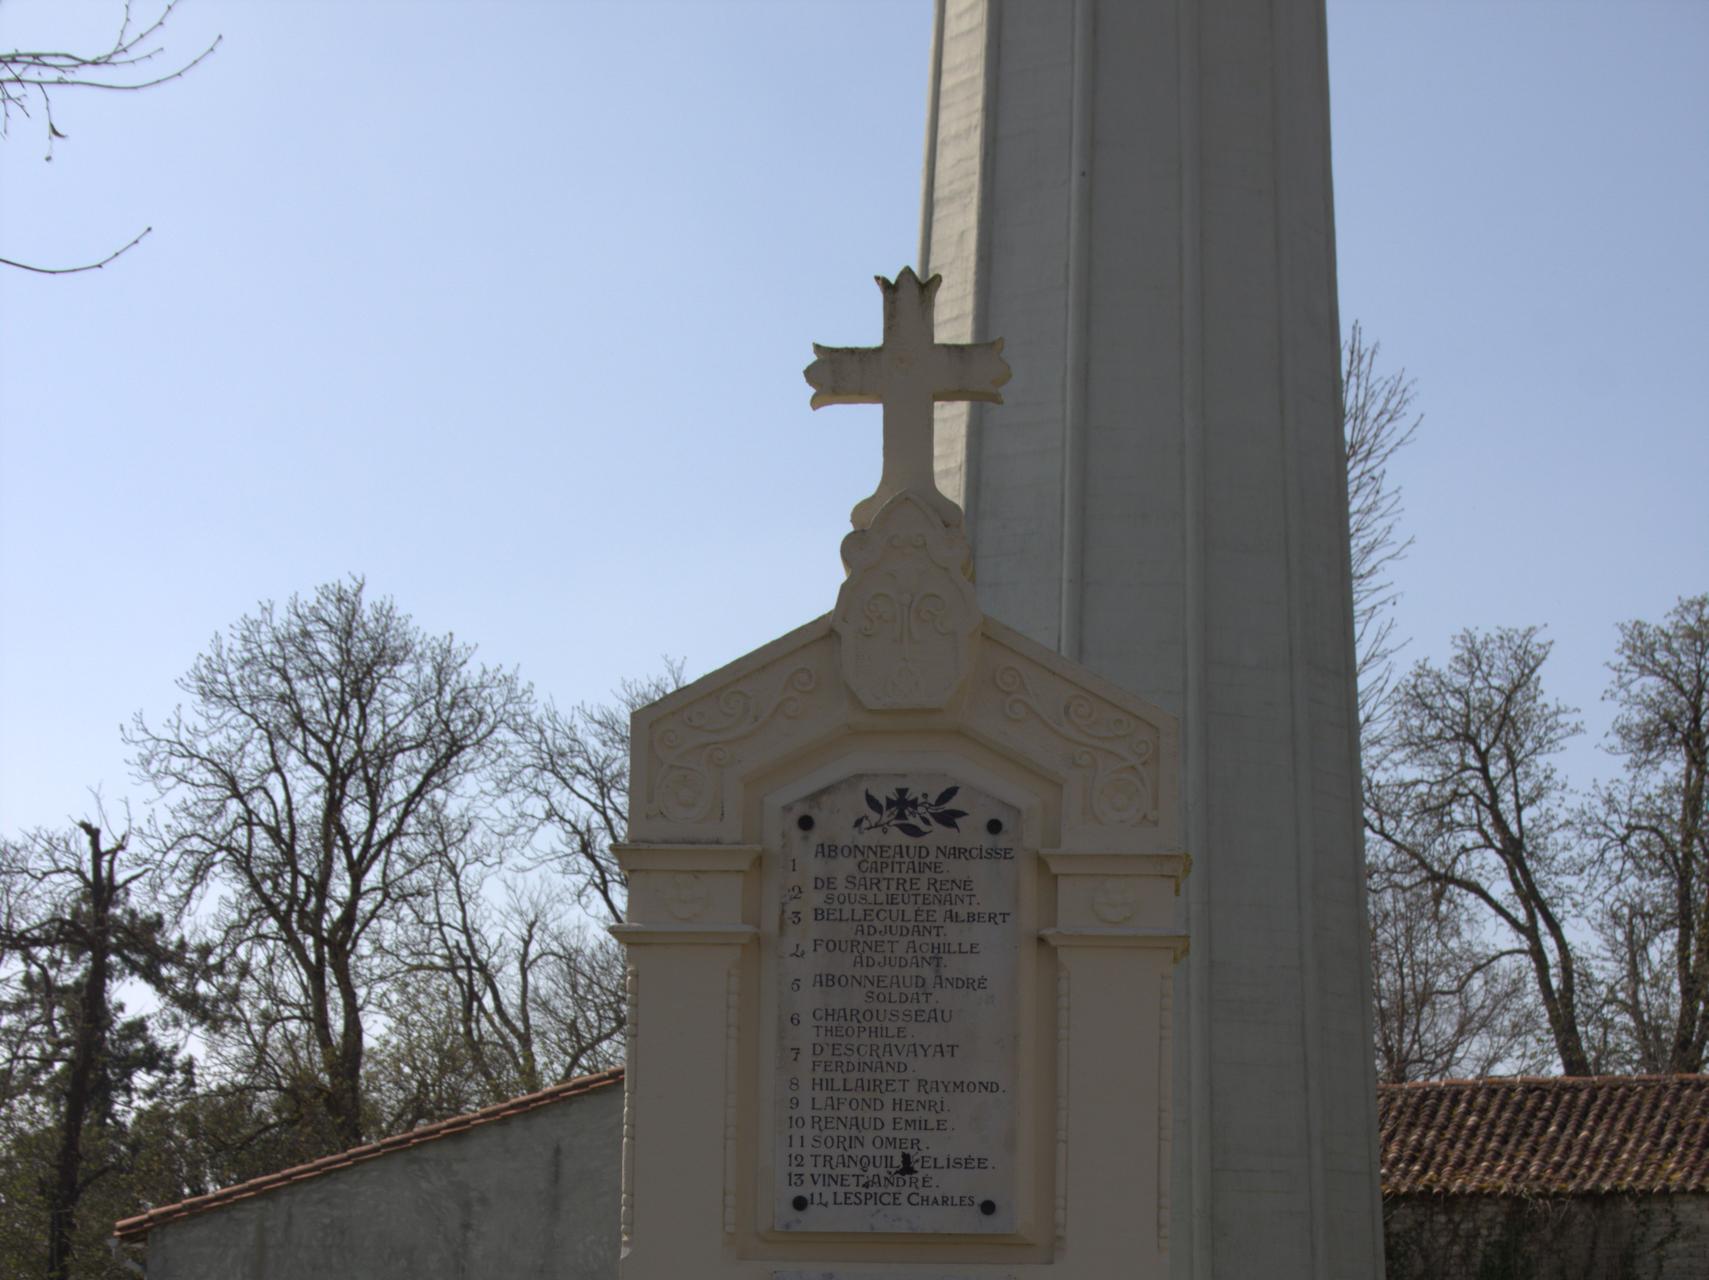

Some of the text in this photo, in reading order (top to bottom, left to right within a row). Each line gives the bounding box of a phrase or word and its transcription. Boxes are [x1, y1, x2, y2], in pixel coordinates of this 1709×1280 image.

[791, 844, 1014, 872] 1 ABONNEAUD NARCISSE
[857, 860, 950, 874] CAPITAINE.
[790, 875, 974, 899] 2 DE SARTRE RENÉ
[791, 907, 1011, 925] 3 BELLECULÉE ALBERT
[854, 926, 948, 937] ADJUDANT.
[813, 939, 899, 955] FOURNET
[905, 942, 980, 955] ACHILLE
[853, 956, 948, 969] ADJUDANT.
[791, 974, 988, 992] 5 ABONNEAUD ANDRÉ
[790, 1008, 953, 1026] 6 CHAROUSSEAU
[790, 1043, 960, 1062] 7 D'ESCRAVAYAT
[812, 1061, 916, 1074] FERDINAND.
[789, 1077, 1006, 1094] 8 HILLAIRET RAYMOND.
[789, 1097, 951, 1114] 9 LAFOND HENRI.
[788, 1116, 806, 1130] 10
[811, 1116, 885, 1132] RENAUD
[788, 1135, 931, 1151] 11 SORIN OMER.
[788, 1154, 804, 1168] 12
[788, 1173, 940, 1189] 13 VINET ANDRÉ.
[833, 1192, 902, 1206] LESPICE
[907, 1192, 975, 1207] CHARLES
